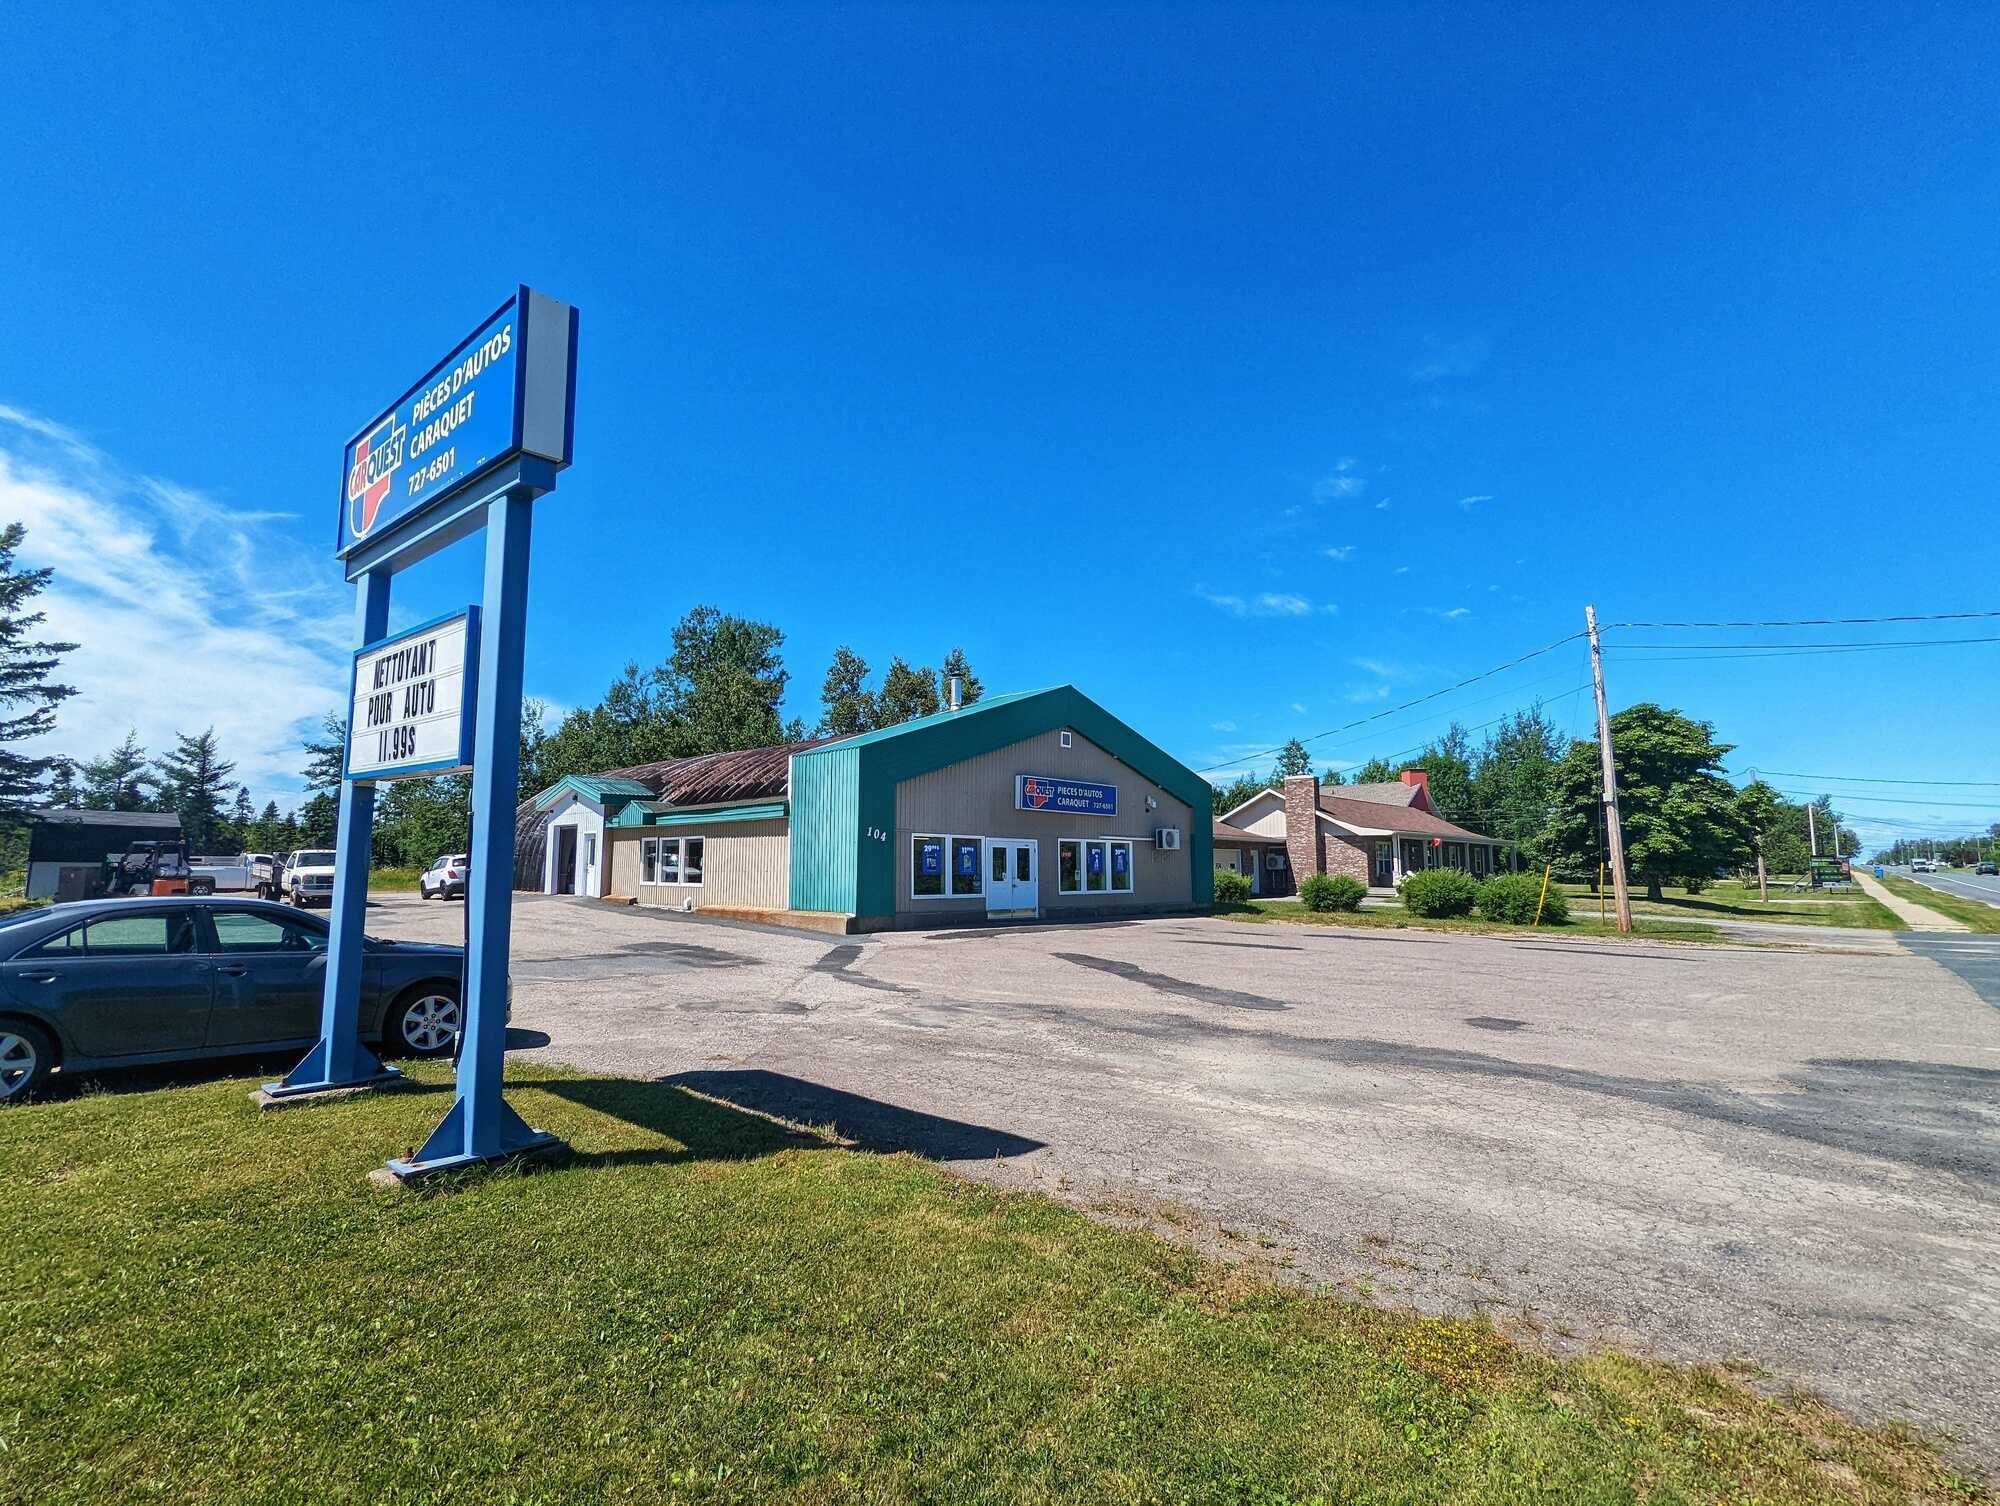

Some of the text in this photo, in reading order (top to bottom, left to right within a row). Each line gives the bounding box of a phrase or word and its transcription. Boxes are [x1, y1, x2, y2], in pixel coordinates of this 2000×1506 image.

[412, 324, 512, 426] PIÈCES D'AUTOS
[410, 391, 475, 459] CARAQUET
[348, 428, 405, 501] CARQUEST
[408, 446, 456, 496] 727-6501
[373, 639, 436, 690] NETTOYANT
[367, 679, 435, 727] POUR AUTO
[1057, 797, 1089, 808] CARAQUET
[866, 826, 887, 841] 104
